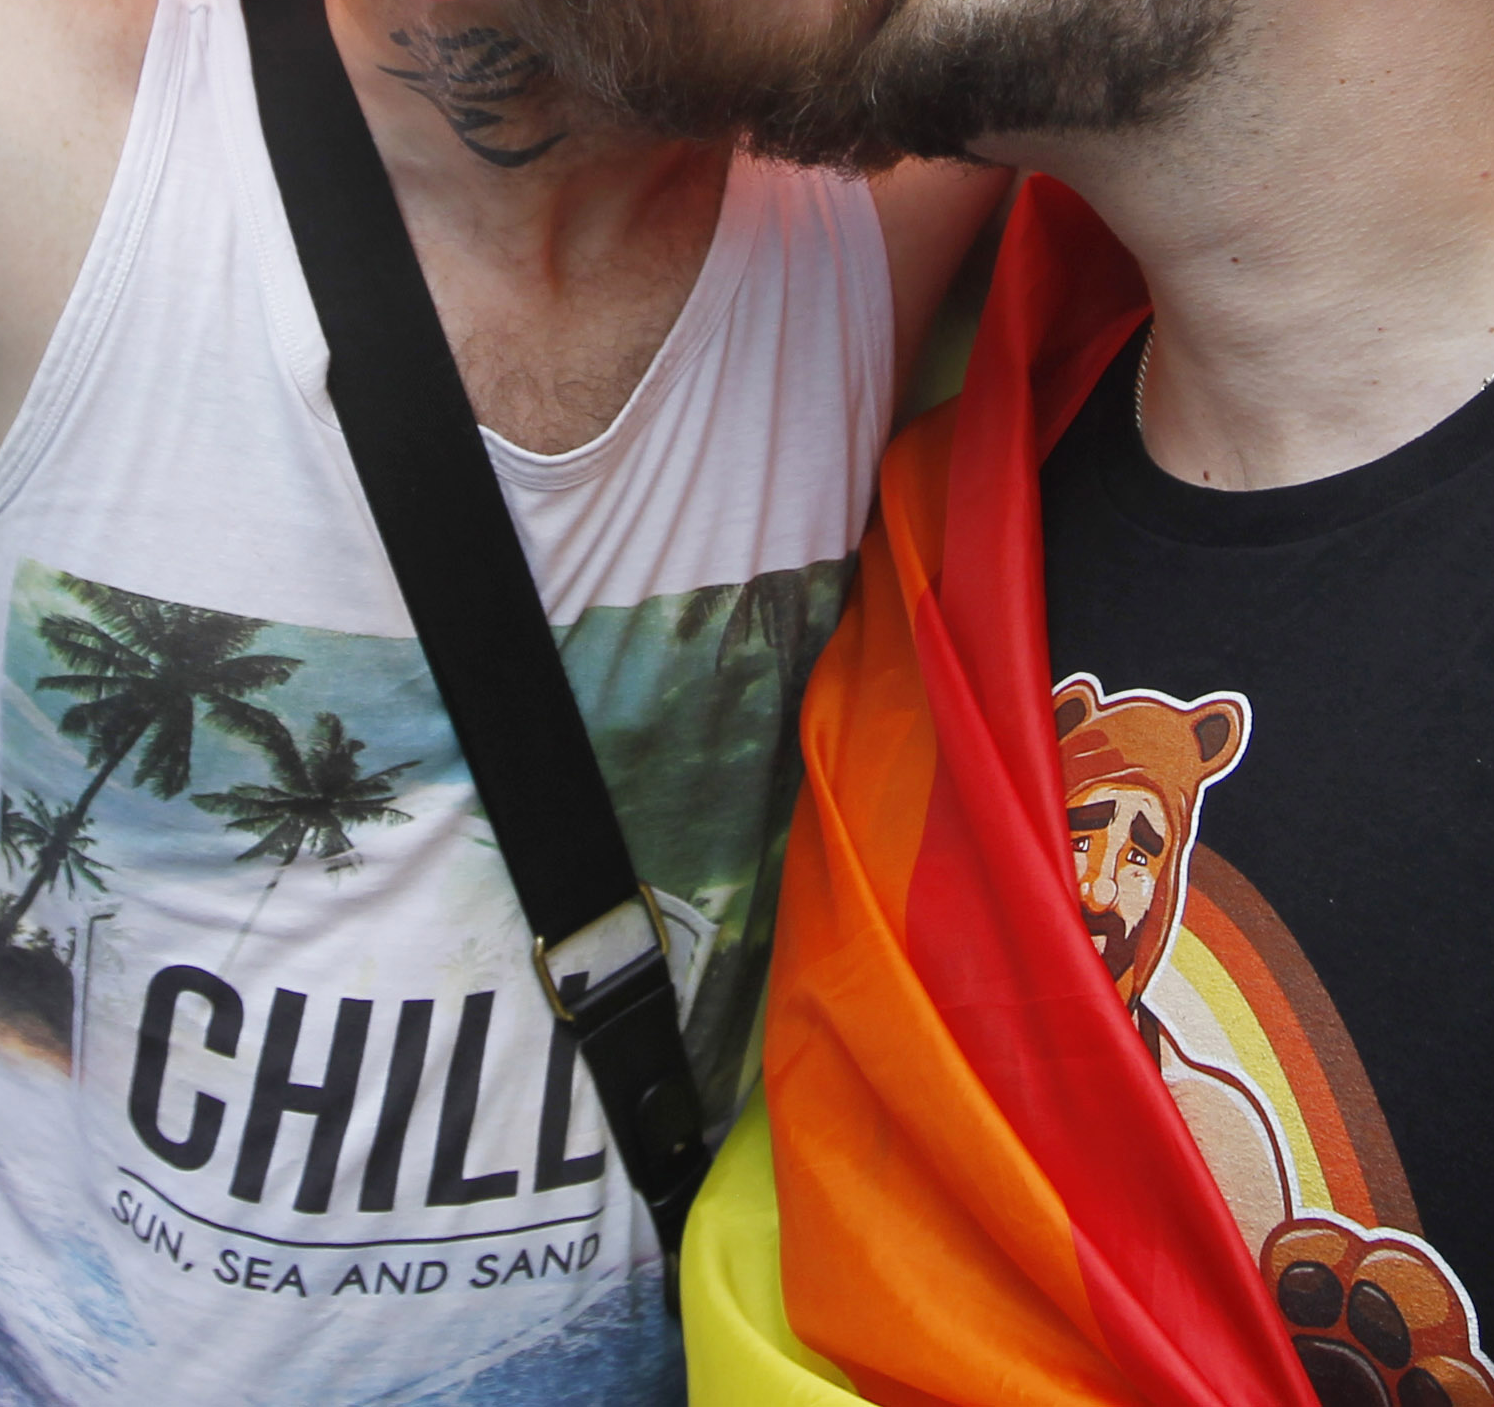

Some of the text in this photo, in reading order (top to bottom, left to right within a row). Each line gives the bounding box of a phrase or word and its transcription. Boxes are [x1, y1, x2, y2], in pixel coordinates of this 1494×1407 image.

[128, 964, 606, 1214] CHILL
[111, 1190, 601, 1298] SUN, SEA AND SAND
